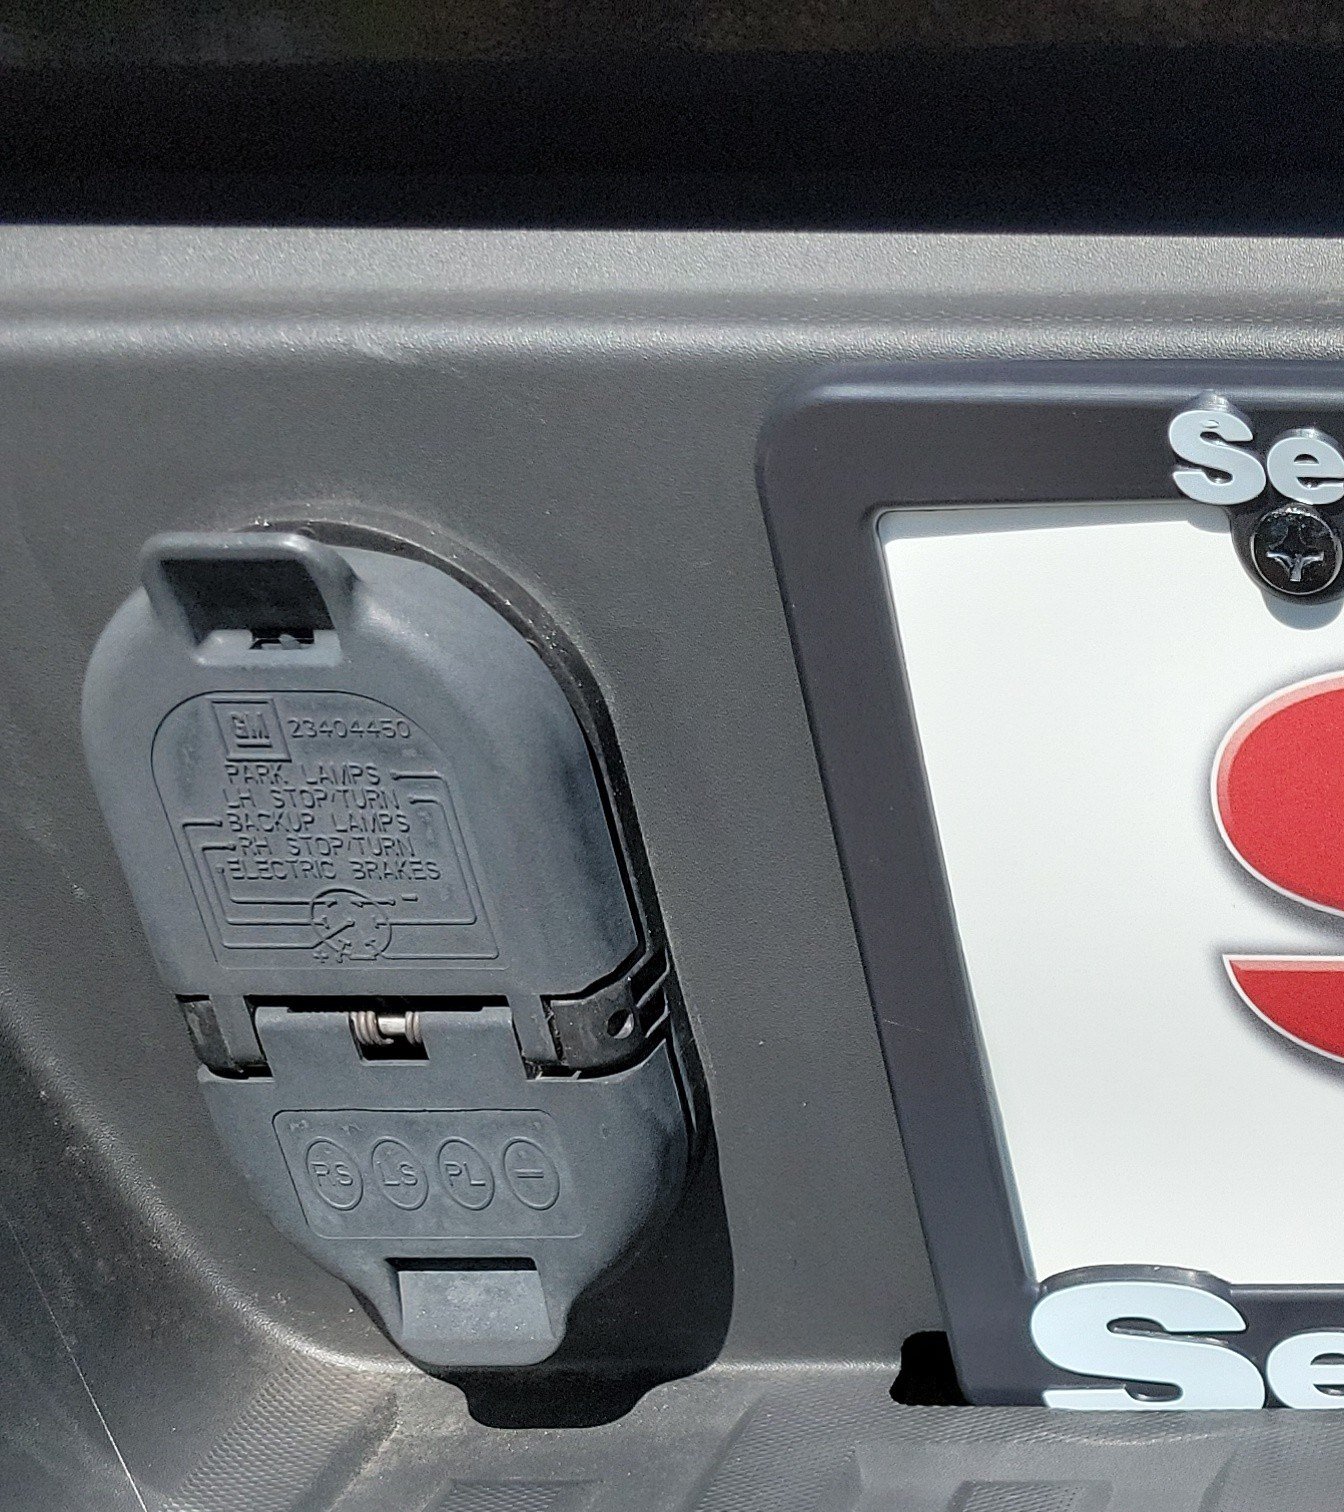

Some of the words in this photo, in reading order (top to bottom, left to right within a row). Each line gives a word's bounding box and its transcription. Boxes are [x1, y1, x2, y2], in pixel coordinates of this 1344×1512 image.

[229, 711, 272, 745] GM
[286, 717, 413, 740] 23404450
[224, 763, 289, 785] PARK
[301, 763, 382, 786] LAMPS
[222, 787, 256, 810] LH
[271, 787, 400, 810] STOP/TURN
[225, 811, 315, 833] BACKUP
[331, 811, 412, 834] LAMPS
[238, 836, 274, 857] RH
[286, 836, 415, 858] STOP/TURN
[228, 859, 337, 881] ELECTRIC
[350, 860, 442, 881] BRAKES
[311, 1162, 355, 1188] RS
[379, 1162, 419, 1188] LS
[443, 1162, 487, 1188] PL
